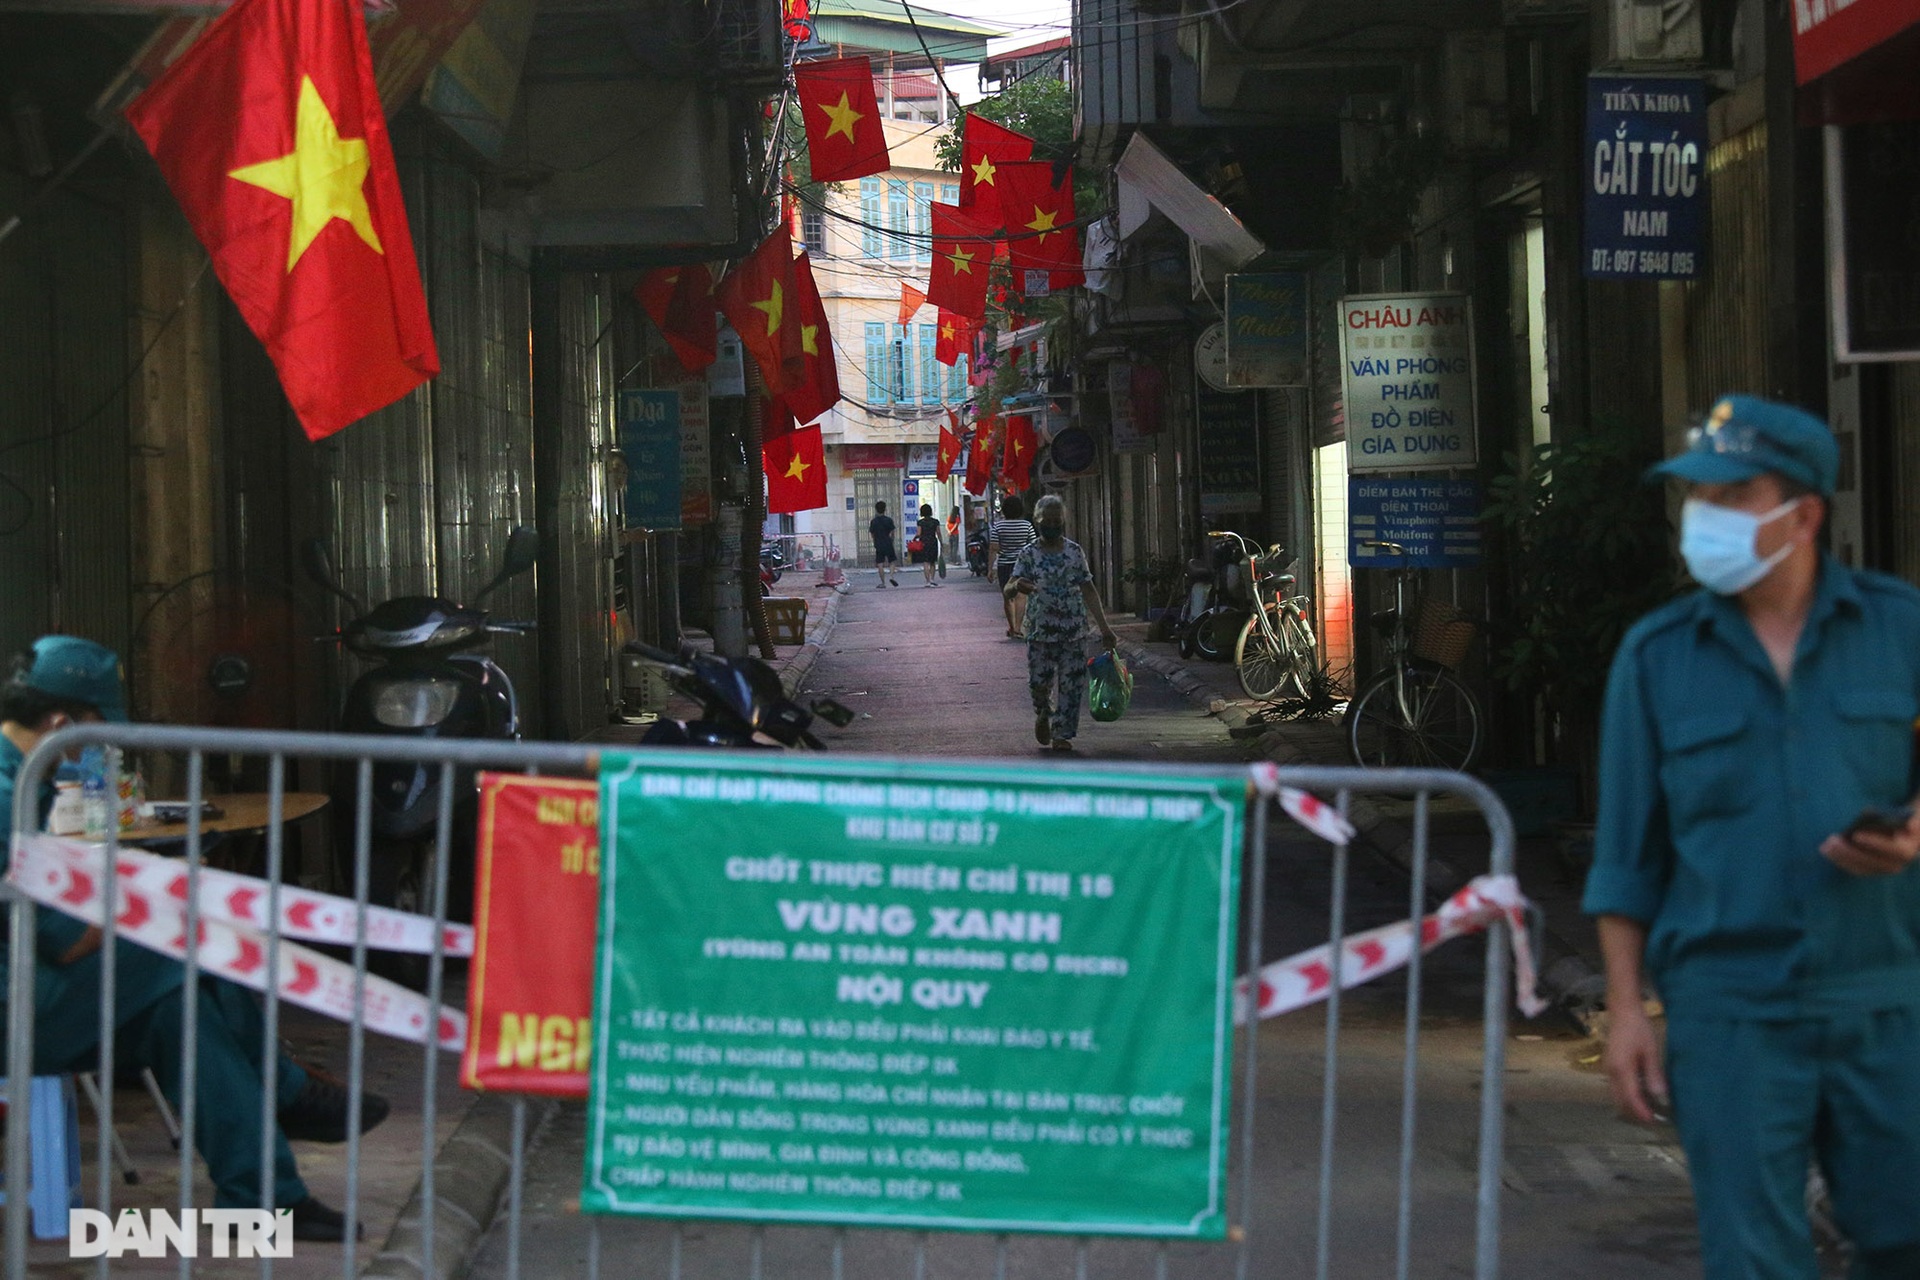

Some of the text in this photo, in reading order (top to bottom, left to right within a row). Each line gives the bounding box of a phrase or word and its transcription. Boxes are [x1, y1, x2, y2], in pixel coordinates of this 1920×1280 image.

[1603, 86, 1691, 113] TIẾN KHOA
[1594, 121, 1698, 198] CẮT TÓC
[1623, 210, 1668, 237] NAM
[1348, 305, 1465, 329] CHÂU ANH
[1350, 352, 1467, 376] VĂN PHÒNG
[1381, 379, 1440, 401] PHẨM
[1371, 405, 1454, 429] ĐỒ ĐIỆN
[1404, 434, 1460, 454] DỤNG
[1382, 530, 1435, 541] Mobifone
[1383, 515, 1440, 527] Vinaphone
[846, 817, 884, 840] KHU
[887, 816, 926, 841] DÂN
[957, 817, 982, 844] SỐ
[986, 821, 998, 845] 7
[725, 853, 1114, 900] CHỐT THỰC HIỆN CHỈ THỊ 16
[777, 895, 1061, 943] VÙNG XANH
[792, 942, 832, 963] AN
[838, 942, 908, 965] TOÀN
[914, 947, 1006, 970] KHÔNG
[1012, 951, 1049, 972] CÓ
[836, 972, 989, 1009] NỘI QUY
[704, 1013, 774, 1035] KHÁCH
[777, 1017, 807, 1037] RA
[809, 1016, 852, 1040] VÀO
[900, 1018, 948, 1044] PHẢI
[952, 1025, 999, 1046] KHAI
[1050, 1030, 1064, 1048] Y
[617, 1039, 959, 1076] THỰC HIỆN NGHIÊM THÔNG ĐIỆP 5K
[625, 1073, 670, 1094] NHU
[673, 1070, 714, 1095] YẾU
[784, 1080, 842, 1102] HÀNG
[891, 1082, 928, 1105] CHỈ
[930, 1084, 987, 1107] NHẬN
[992, 1088, 1023, 1111] TẠI
[1026, 1090, 1069, 1112] BÀN
[1073, 1092, 1126, 1115] TRỰC
[1129, 1091, 1185, 1116] CHỐT
[691, 1105, 735, 1128] DÂN
[737, 1104, 796, 1131] SỐNG
[800, 1111, 870, 1135] TRONG
[872, 1114, 930, 1137] VÙNG
[934, 1119, 988, 1138] XANH
[1037, 1119, 1086, 1144] PHẢI
[779, 1142, 815, 1162] GIA
[817, 1144, 869, 1166] ĐÌNH
[870, 1144, 900, 1167] VÀ
[902, 1146, 961, 1170] CỘNG
[609, 1163, 963, 1201] CHẤP HÀNH NGHIÊM THÔNG ĐIỆP 5K
